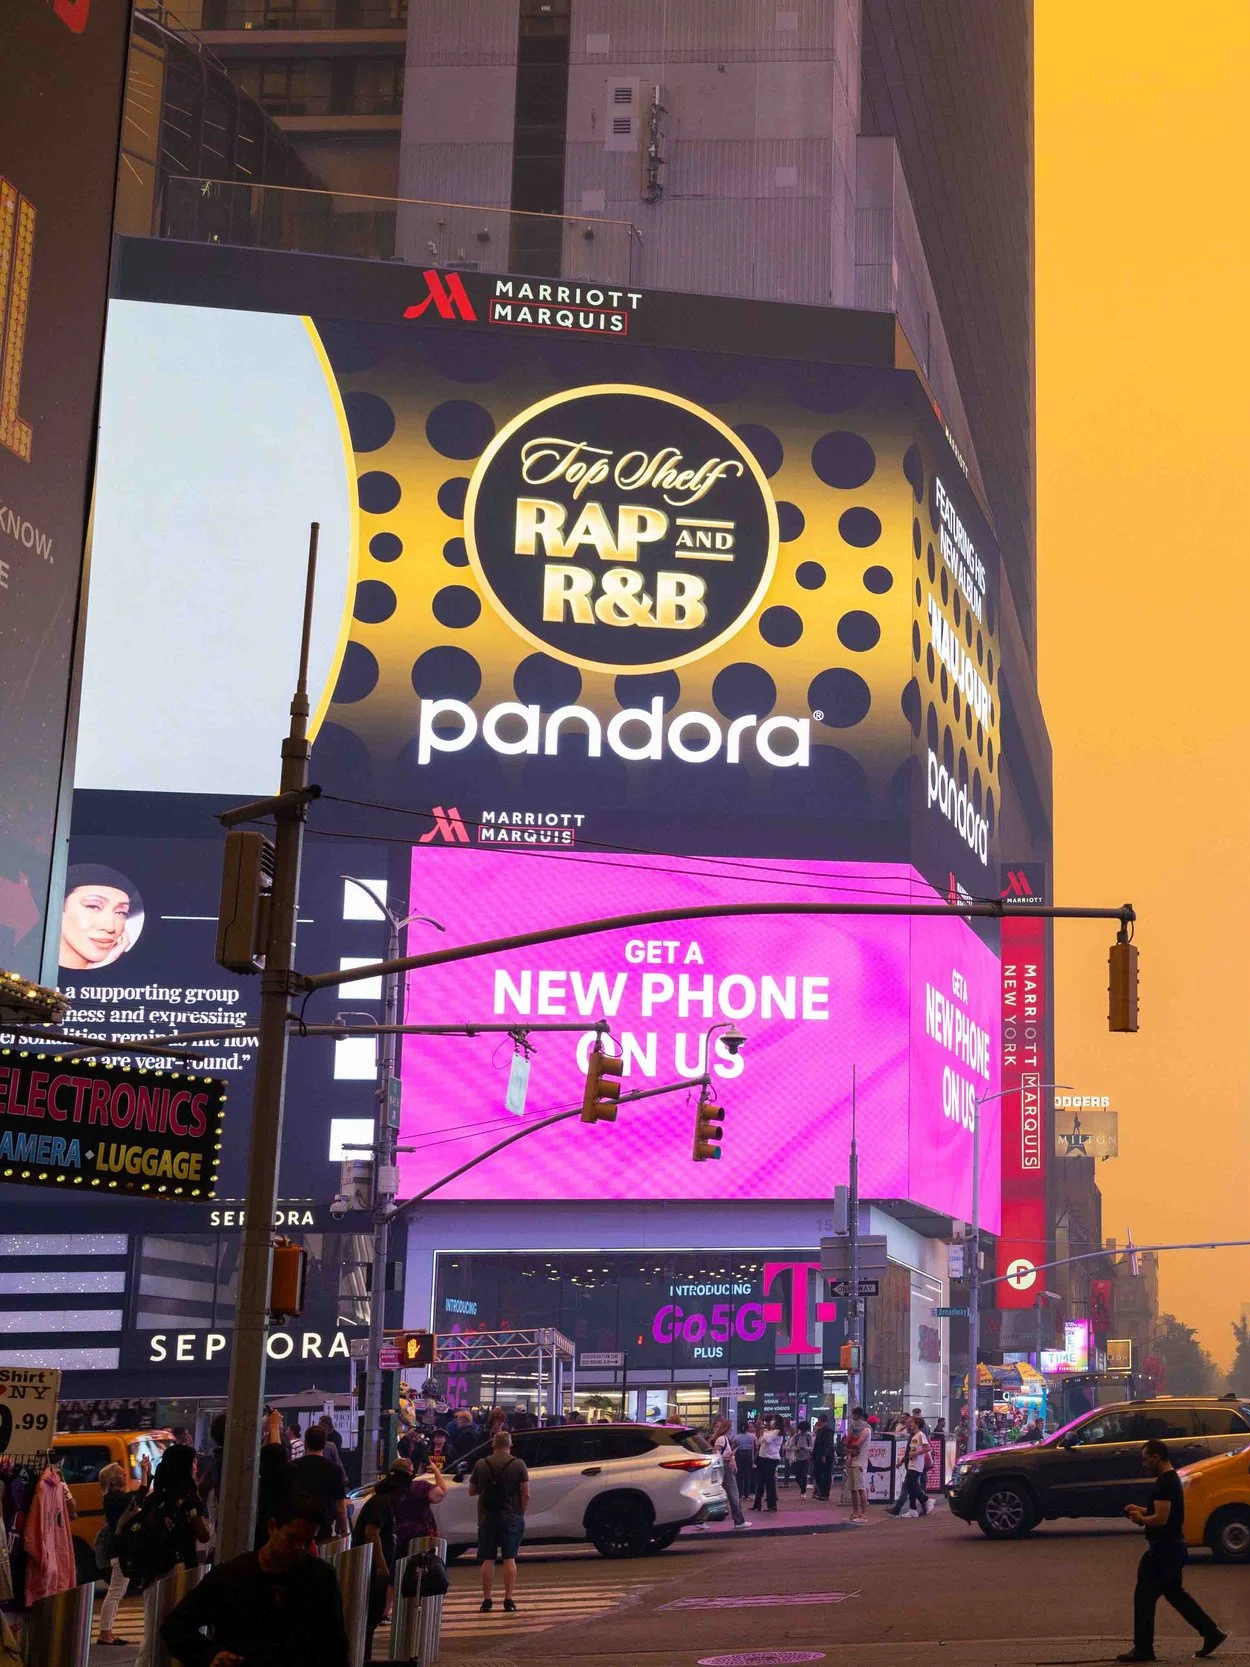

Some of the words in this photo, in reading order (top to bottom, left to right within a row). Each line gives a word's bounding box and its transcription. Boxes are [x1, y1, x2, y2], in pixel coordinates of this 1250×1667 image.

[495, 280, 643, 310] MARRIOTT
[494, 303, 624, 332] MARQUIS
[521, 437, 614, 500] Top
[614, 447, 744, 507] Shelf
[514, 497, 669, 563] RAP
[675, 529, 735, 550] AND
[936, 476, 975, 568] FEATURING
[974, 552, 986, 595] HIS
[940, 523, 959, 579] NEW
[959, 560, 982, 625] ALBUM
[542, 563, 708, 630] R&B
[417, 696, 811, 767] pandora
[481, 810, 586, 826] MARRIOTT
[927, 748, 989, 867] pandora
[481, 827, 572, 844] MARQUIS
[624, 939, 680, 965] GET
[683, 941, 704, 965] A
[65, 987, 77, 1000] a
[81, 984, 182, 1005] supporting
[185, 988, 240, 1005] group
[493, 969, 629, 1017] NEW
[640, 972, 830, 1021] PHONE
[952, 968, 963, 999] GET
[962, 979, 969, 1006] A
[1003, 965, 1017, 1006] NEW
[64, 1010, 108, 1024] ness
[110, 1006, 145, 1023] and
[149, 1010, 248, 1028] expressing
[926, 981, 957, 1051] NEW
[955, 1006, 990, 1081] PHONE
[1024, 964, 1038, 1067] MARRIOTT
[674, 1032, 746, 1080] US
[1003, 1014, 1017, 1066] YORK
[942, 1065, 960, 1124] ON
[960, 1077, 976, 1134] US
[1054, 1096, 1110, 1107] ODGERS
[1024, 1076, 1038, 1167] MARQUIS
[1057, 1135, 1117, 1145] MILTON
[0, 1130, 82, 1169] AMERA
[96, 1142, 203, 1181] LUGGAGE
[210, 1210, 314, 1226] SEORA
[669, 1283, 752, 1297] INTRODUCING
[1016, 1265, 1029, 1285] P
[445, 1298, 478, 1316] INTRODUCING
[652, 1302, 767, 1344] Go5G
[938, 1308, 967, 1316] Broadway
[150, 1332, 351, 1362] SEPORA
[694, 1346, 723, 1359] PLUS
[7, 1384, 52, 1399] NY
